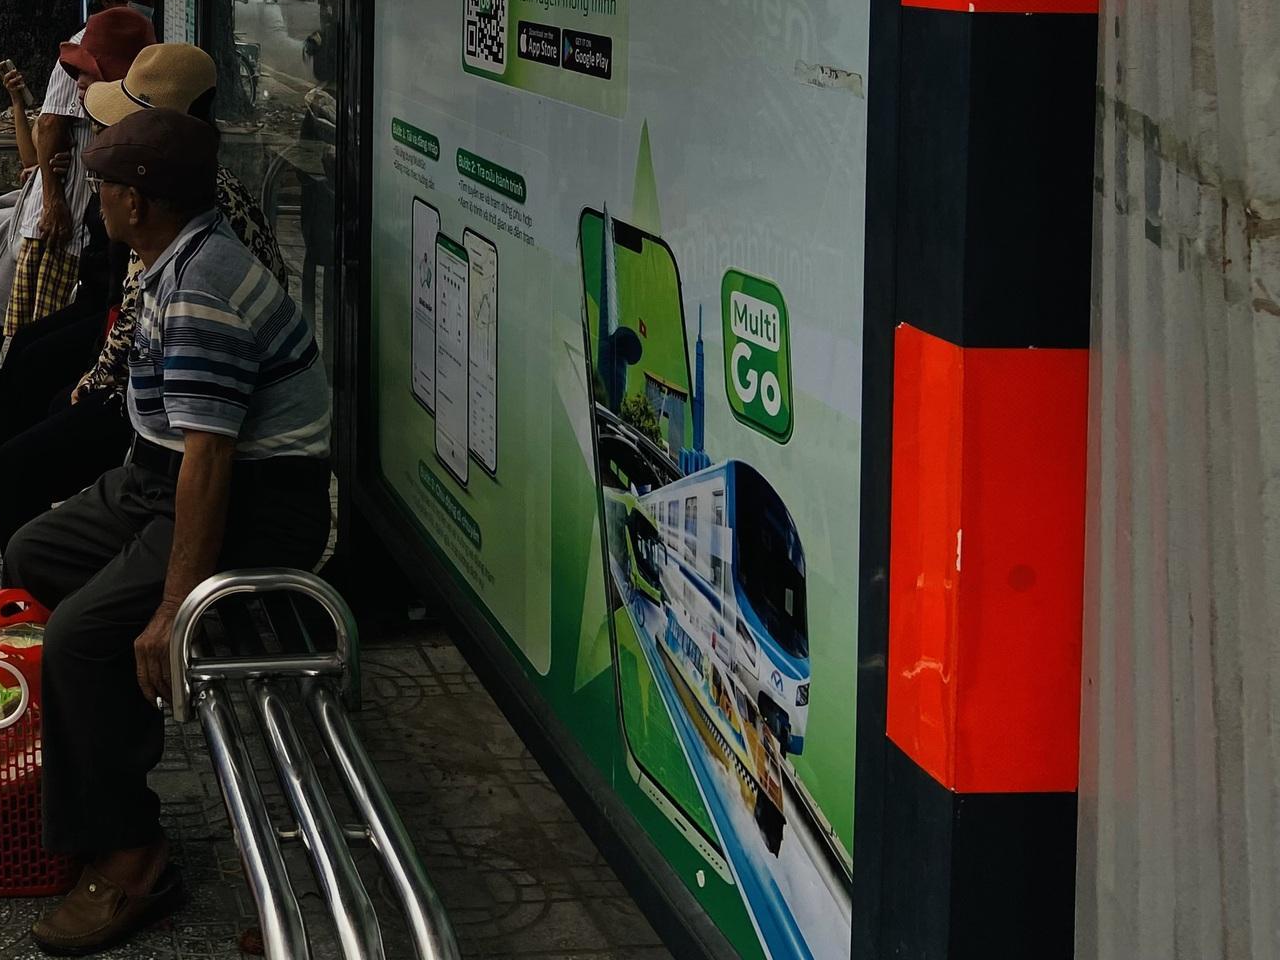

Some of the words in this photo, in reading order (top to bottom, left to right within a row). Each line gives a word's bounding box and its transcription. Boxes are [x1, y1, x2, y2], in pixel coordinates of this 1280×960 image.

[528, 38, 540, 57] App
[541, 40, 558, 58] Store
[574, 48, 595, 68] Google
[596, 53, 609, 72] Play
[734, 299, 777, 344] Multi
[730, 341, 782, 418] Go
